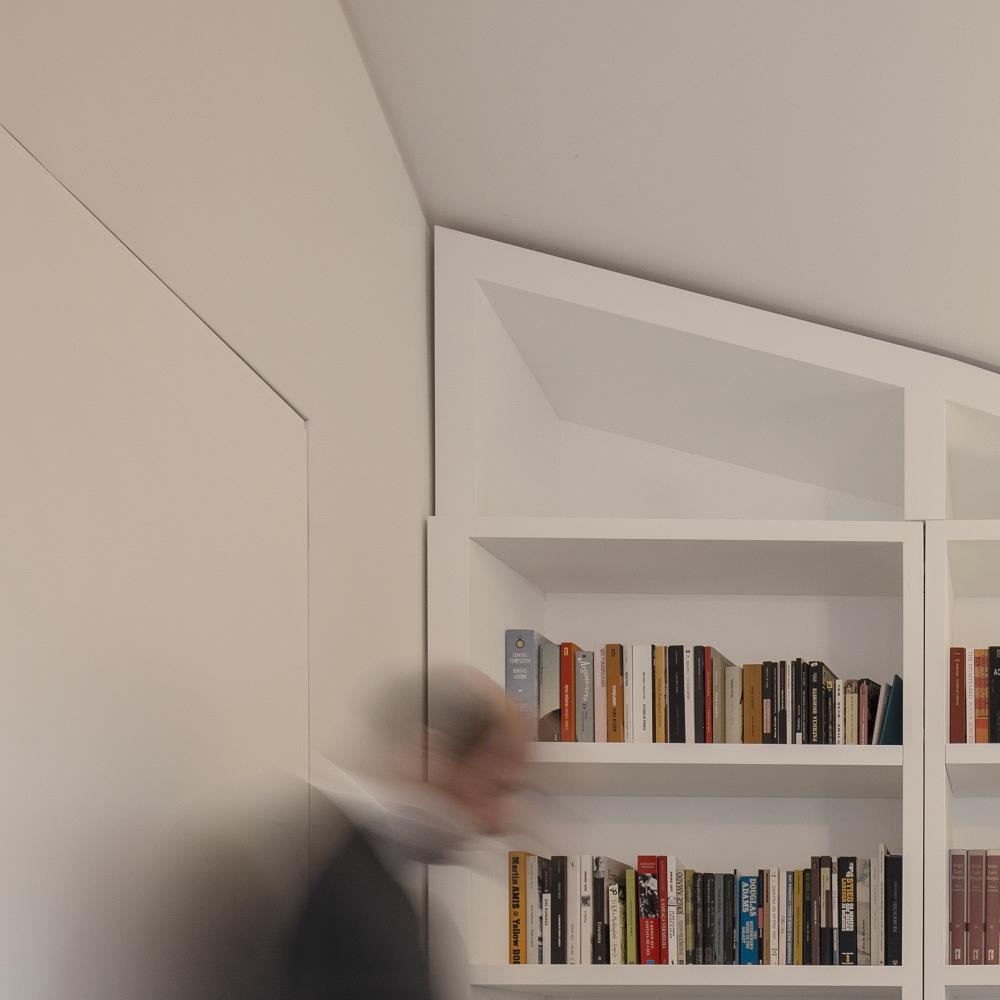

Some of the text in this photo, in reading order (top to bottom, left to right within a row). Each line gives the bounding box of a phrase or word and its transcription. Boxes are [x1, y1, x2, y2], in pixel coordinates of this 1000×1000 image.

[676, 872, 684, 896] AMADO
[846, 878, 854, 902] STIEG
[676, 897, 684, 915] JORGE
[512, 919, 520, 946] Yellow
